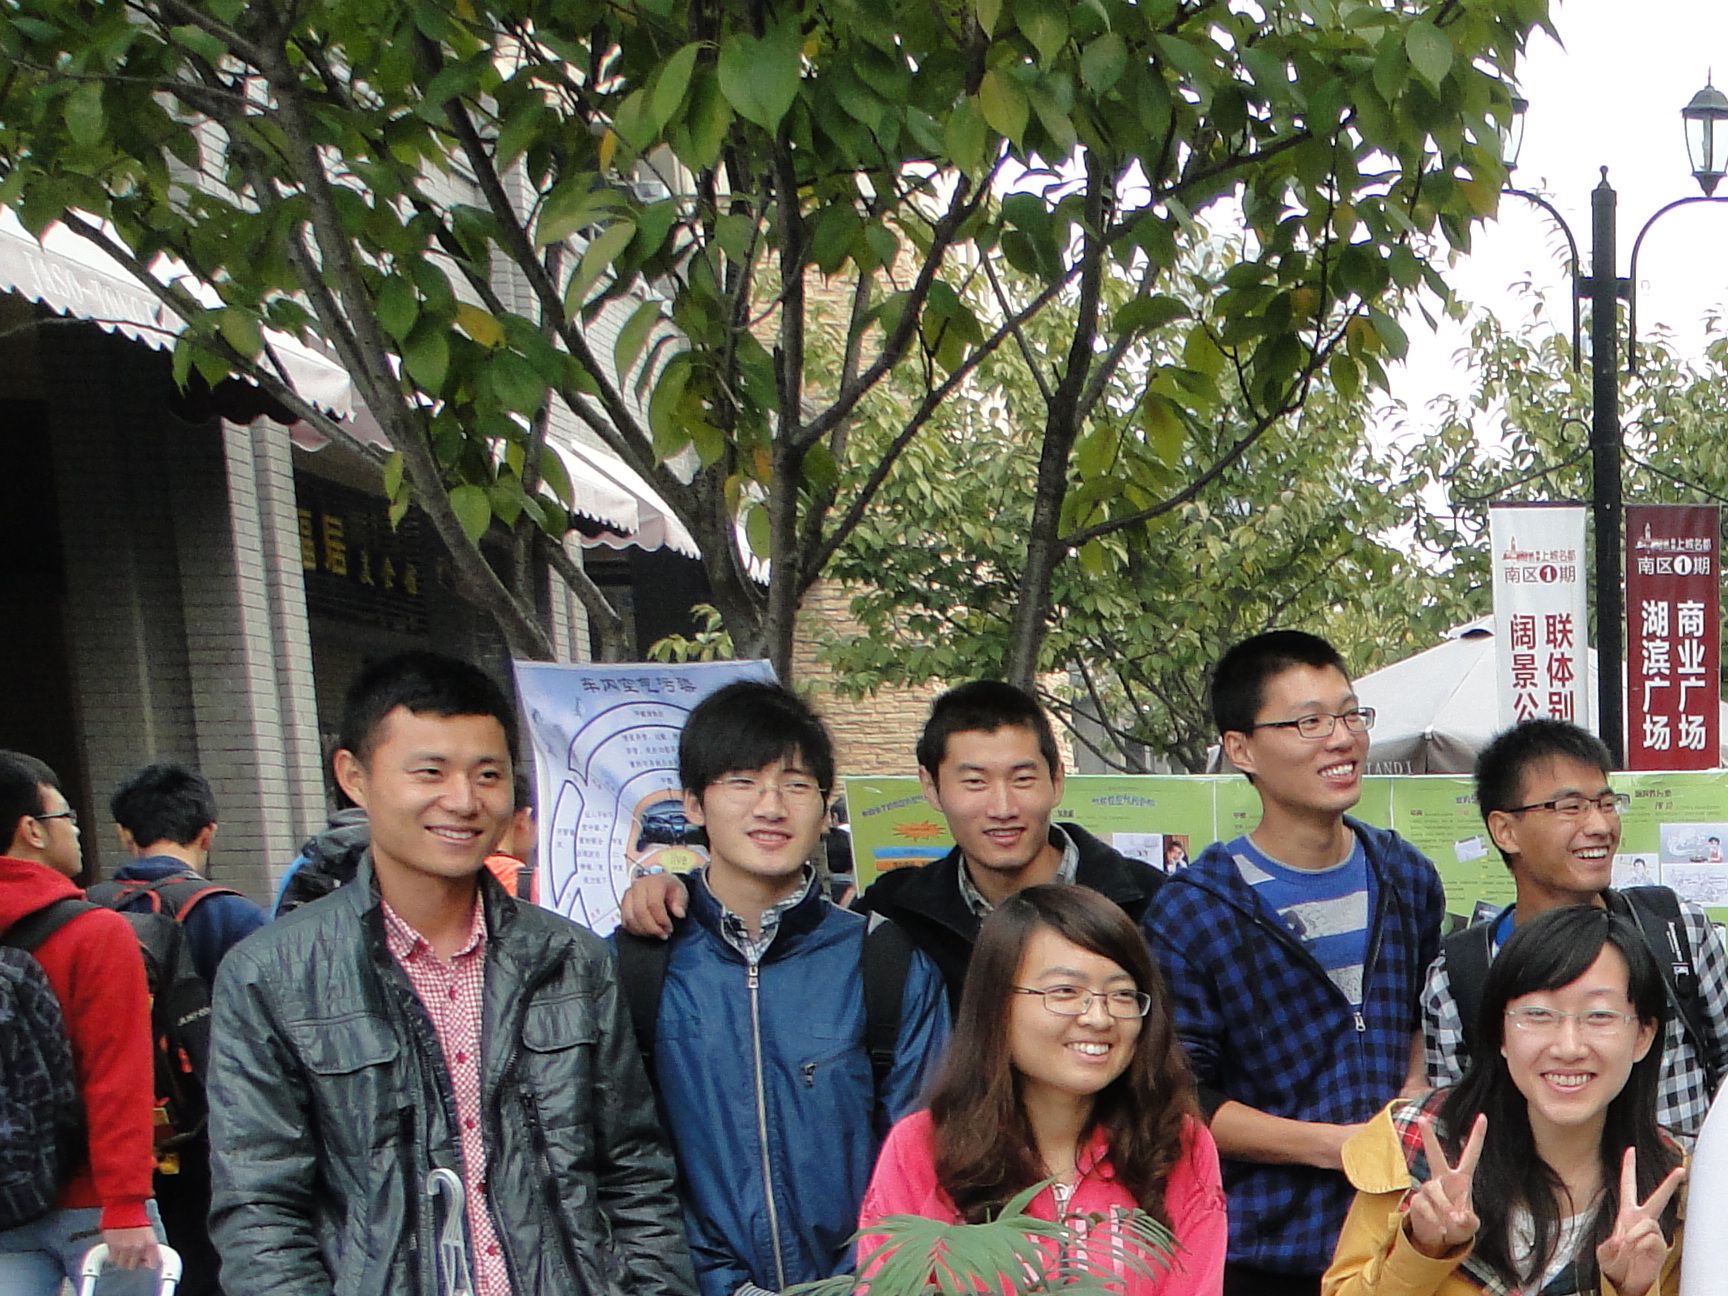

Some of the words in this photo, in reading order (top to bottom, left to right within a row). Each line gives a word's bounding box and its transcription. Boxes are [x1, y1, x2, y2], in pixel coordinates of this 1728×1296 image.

[580, 677, 696, 694] 车内空气污染
[1641, 600, 1671, 750] 湖滨广场
[1677, 600, 1706, 751] 商业广场
